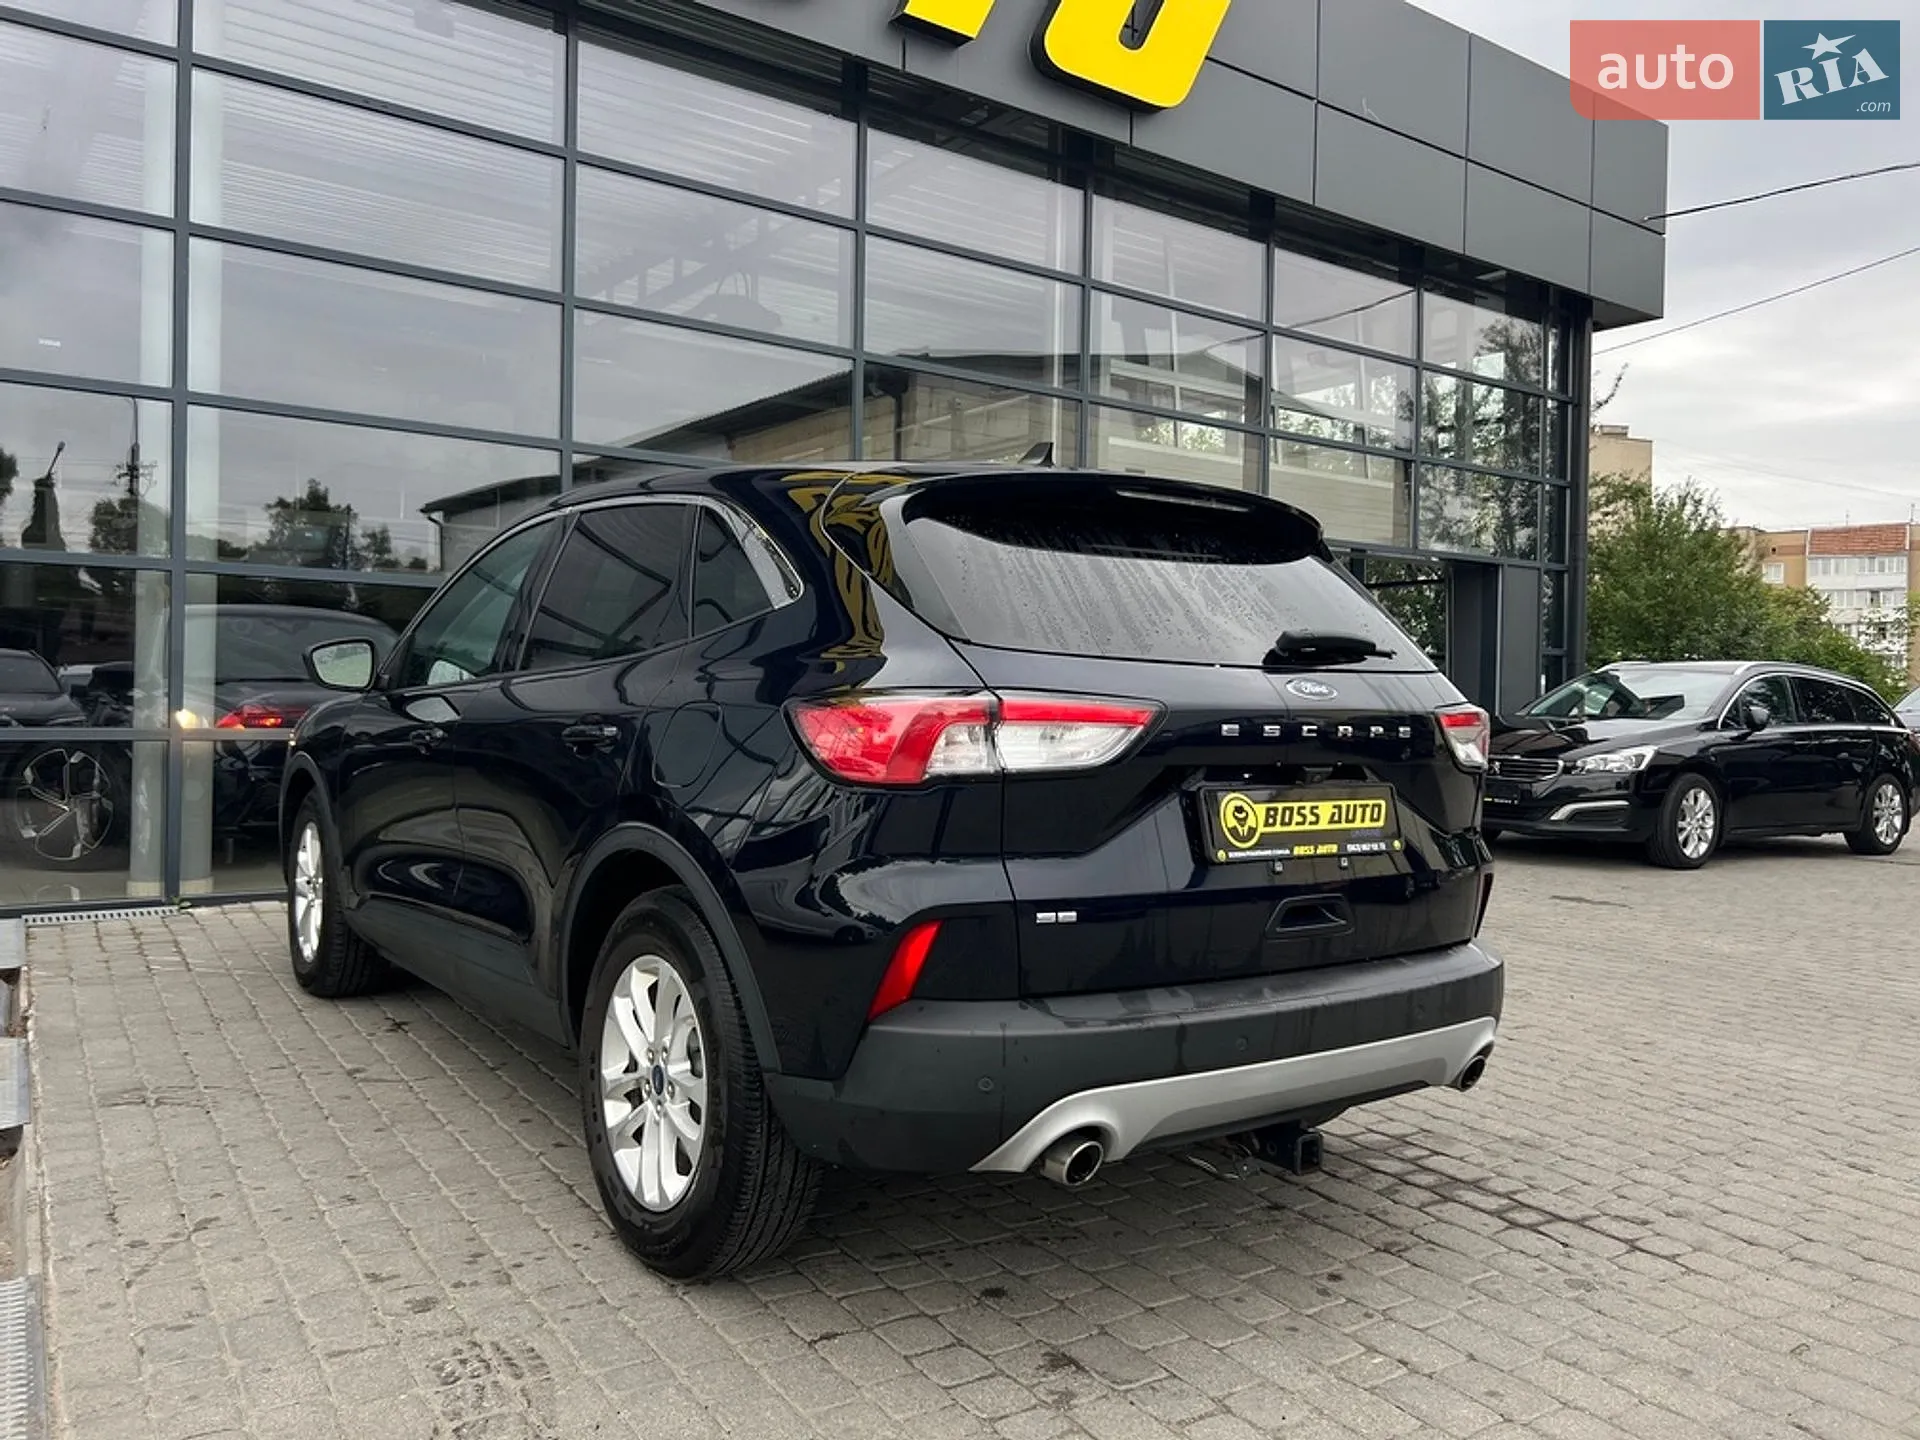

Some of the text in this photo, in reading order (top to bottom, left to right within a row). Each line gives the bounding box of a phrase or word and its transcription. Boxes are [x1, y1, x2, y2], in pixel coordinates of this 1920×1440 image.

[1220, 723, 1412, 738] ESCAPE
[1262, 803, 1383, 828] BOSS AUTO
